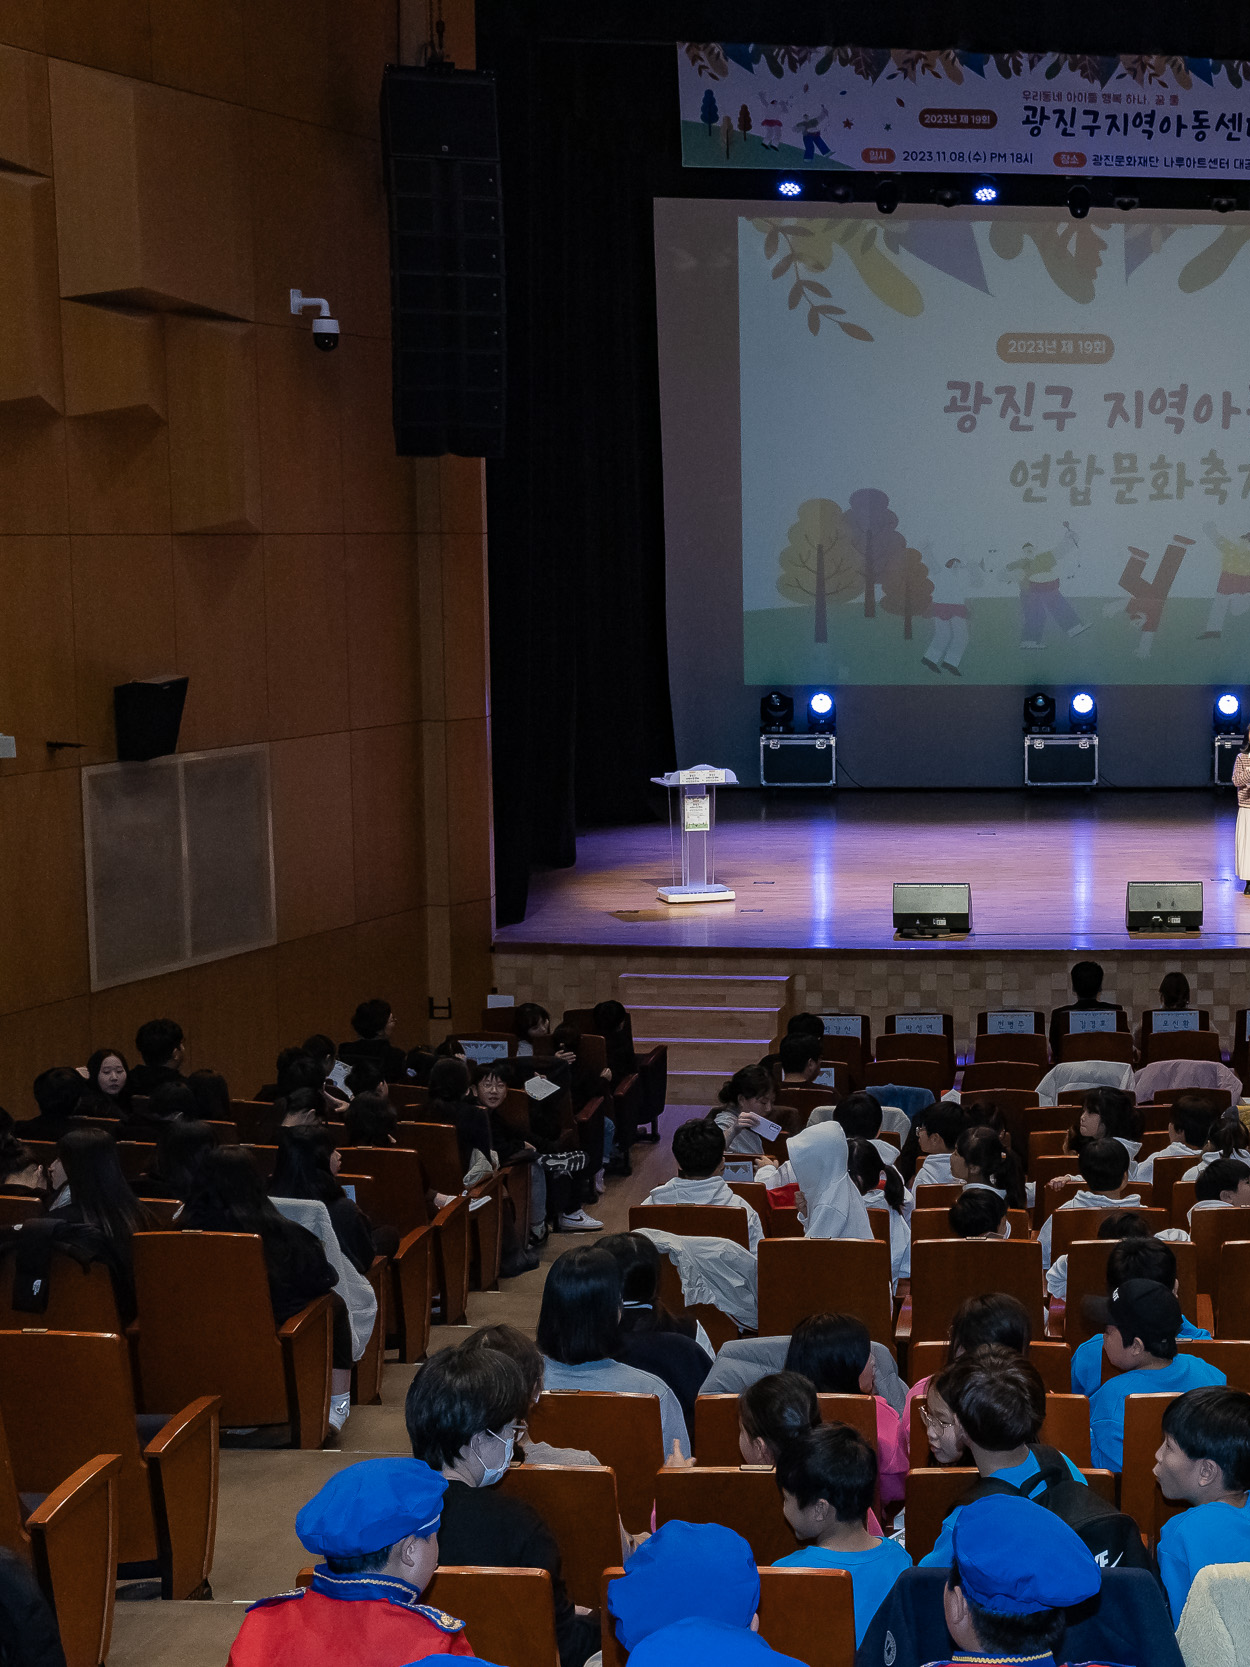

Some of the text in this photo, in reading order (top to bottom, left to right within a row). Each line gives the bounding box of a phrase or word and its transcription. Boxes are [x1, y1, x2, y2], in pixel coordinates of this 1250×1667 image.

[924, 113, 991, 125] 2023년 제 19회
[869, 151, 887, 162] 일시
[990, 152, 1007, 163] PM
[1010, 152, 1033, 164] 18시
[1092, 154, 1159, 168] 광진문화재단
[1163, 156, 1230, 170] 나루아트센터
[1007, 339, 1107, 356] 2023년 제 19회
[943, 379, 1078, 434] 광진구
